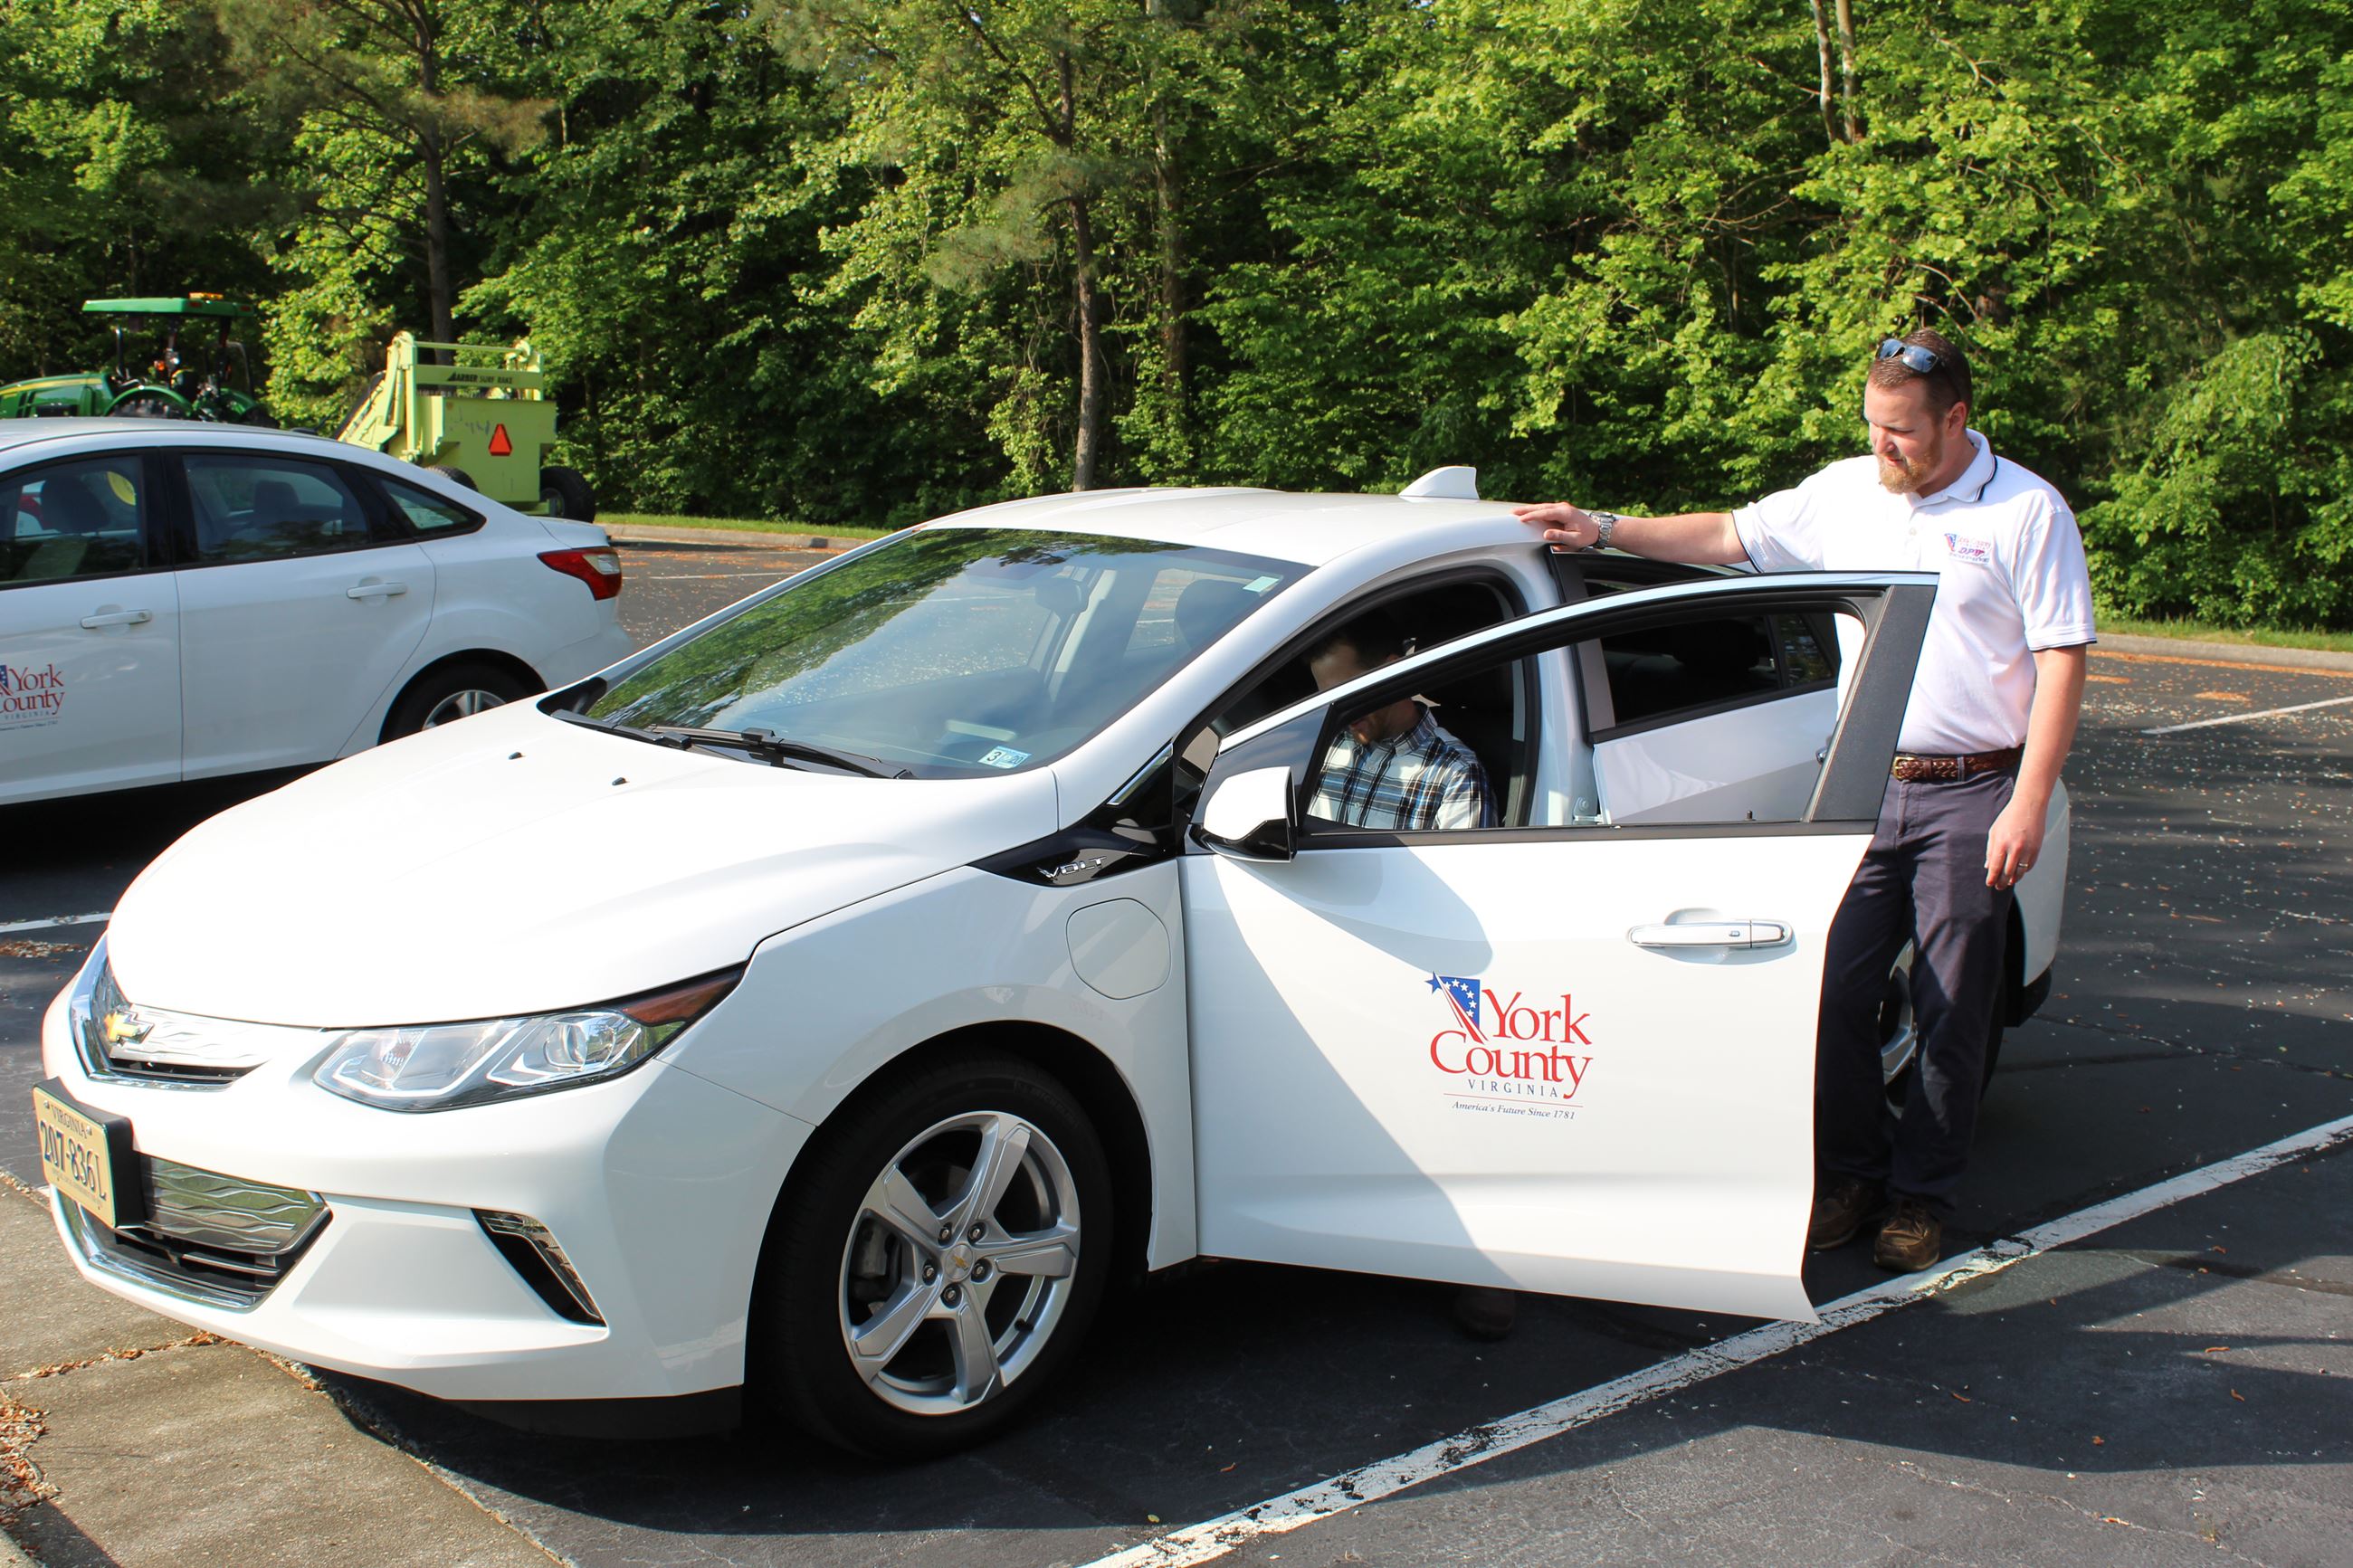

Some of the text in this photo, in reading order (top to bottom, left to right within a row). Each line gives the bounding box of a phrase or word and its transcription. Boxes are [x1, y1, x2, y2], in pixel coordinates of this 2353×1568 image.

[8, 663, 64, 692] York
[0, 689, 65, 716] ounty
[5, 710, 50, 720] VIRGINIA
[986, 751, 1002, 762] 3
[1036, 855, 1107, 880] VOLT
[1481, 988, 1593, 1045] York
[1430, 1030, 1594, 1099] County
[1467, 1079, 1558, 1098] VIRGINIA
[50, 1105, 88, 1140] VIRGINIA
[1452, 1101, 1576, 1120] America's Future Since 1781
[40, 1120, 107, 1201] 207-836L
